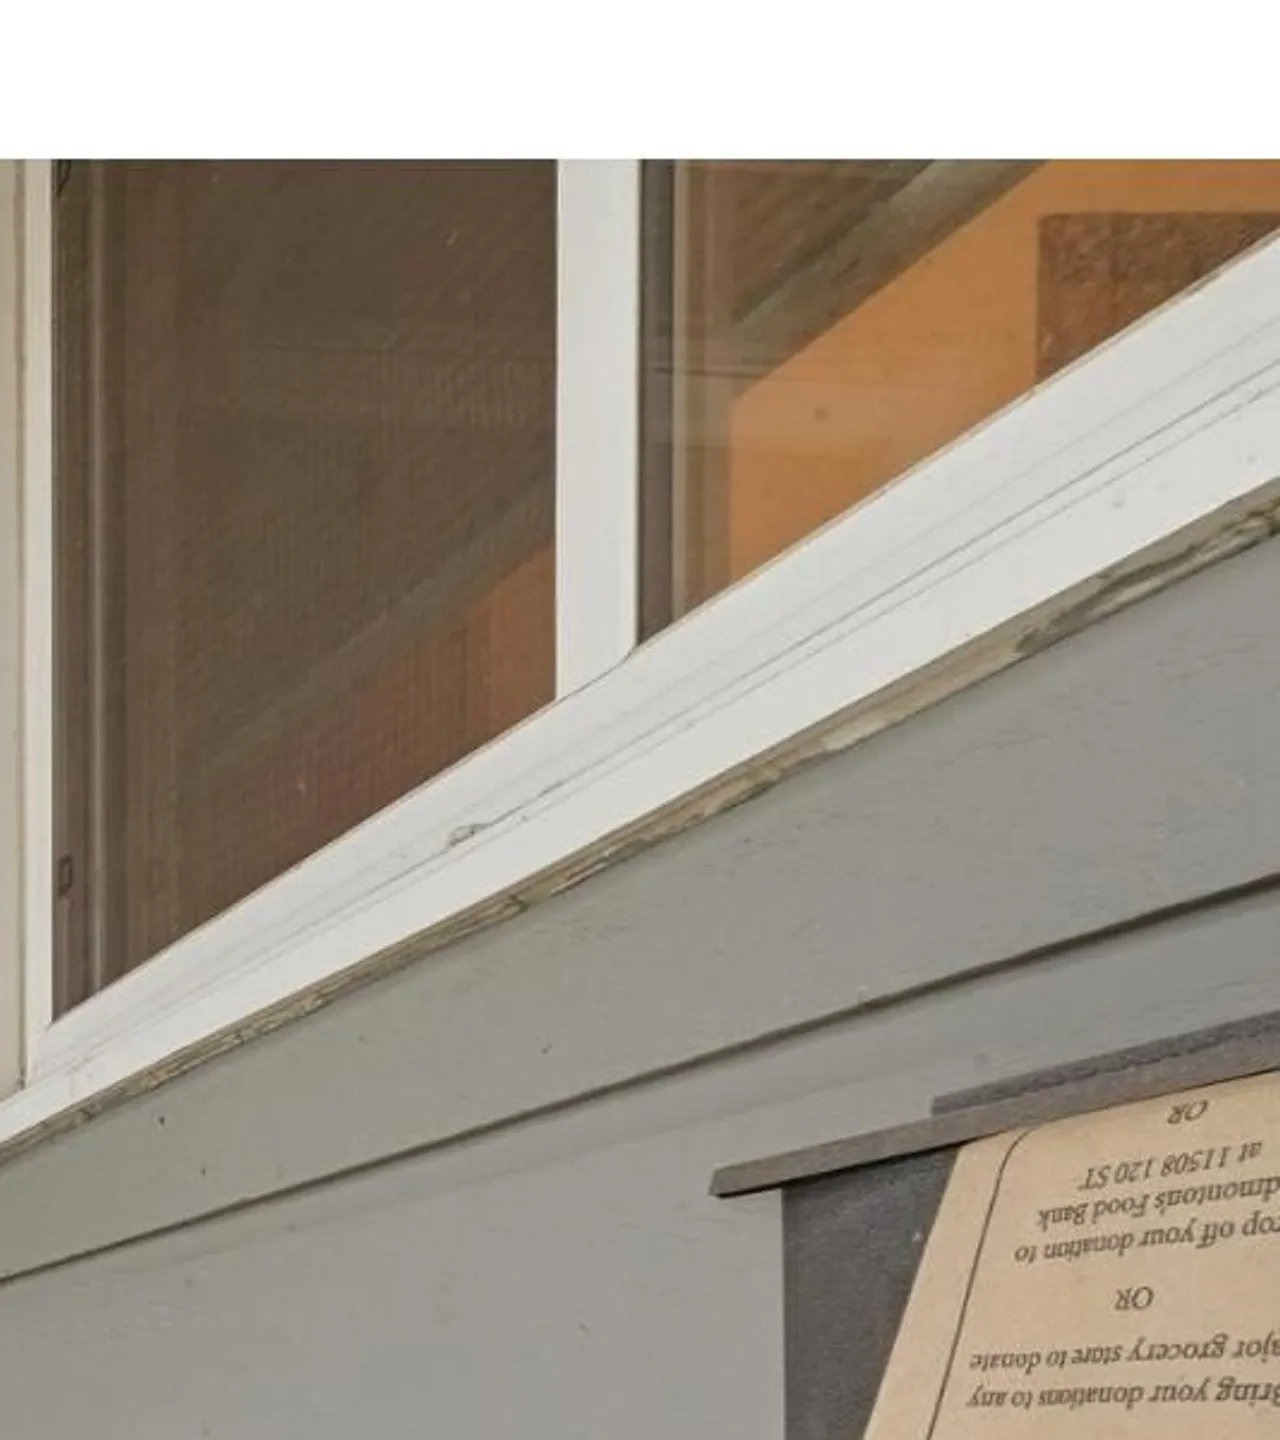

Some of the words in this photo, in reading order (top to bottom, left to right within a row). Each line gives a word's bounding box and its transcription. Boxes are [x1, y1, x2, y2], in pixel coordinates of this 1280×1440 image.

[1166, 1099, 1209, 1125] OR
[1161, 1146, 1232, 1178] 11508
[1238, 1141, 1263, 1163] at
[1076, 1165, 1111, 1190] ST
[1114, 1159, 1154, 1185] 120
[1036, 1204, 1089, 1232] Bank
[1092, 1195, 1150, 1224] Food
[1139, 1217, 1196, 1248] your
[1196, 1221, 1236, 1249] off
[1013, 1245, 1037, 1264] to
[1044, 1233, 1135, 1262] donation
[1115, 1286, 1154, 1311] OR
[1046, 1350, 1067, 1370] to
[1126, 1334, 1229, 1363] grocery
[970, 1353, 1041, 1375] donate
[966, 1386, 1007, 1407] any
[1011, 1392, 1033, 1410] to
[1039, 1386, 1145, 1410] donations
[1148, 1379, 1210, 1405] your
